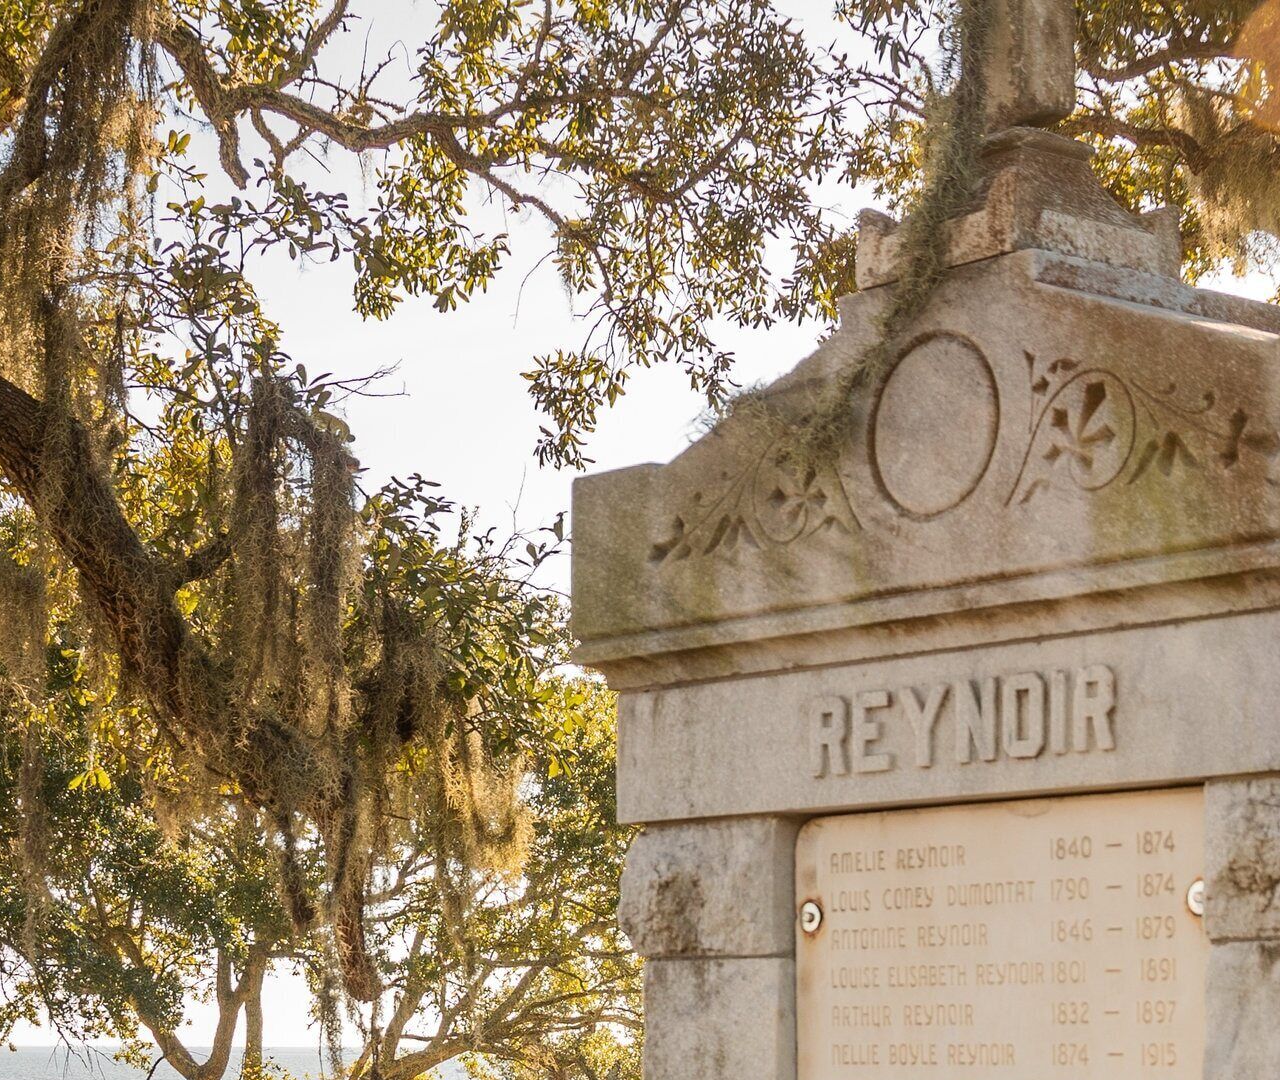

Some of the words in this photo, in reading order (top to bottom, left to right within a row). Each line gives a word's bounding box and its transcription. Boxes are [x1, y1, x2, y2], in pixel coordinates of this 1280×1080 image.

[813, 664, 1117, 777] REYNOIR
[829, 849, 887, 875] AMELIE
[895, 843, 967, 871] REYNOIR
[1049, 834, 1093, 862] 1840
[1135, 829, 1177, 856] 1874
[830, 888, 872, 914] LOUIS
[881, 885, 935, 912] CONEY
[1050, 876, 1091, 903] 1790
[1136, 872, 1177, 899] 1874
[830, 925, 907, 952] ANTONINE
[916, 922, 989, 949] REYNOIR
[1050, 917, 1094, 944] 1846
[1135, 914, 1177, 940] 1879
[830, 966, 881, 990] LOUISE
[887, 963, 968, 989] ELISABETH
[975, 960, 1045, 987] REYNOIR
[1050, 959, 1087, 985] 1801
[1140, 957, 1178, 984] 1891
[831, 1004, 893, 1028] ARTHUR
[903, 1002, 975, 1027] REYNOIR
[1051, 1000, 1091, 1027] 1832
[1136, 999, 1178, 1026] 1897
[831, 1043, 881, 1067] NELLIE
[888, 1042, 939, 1068] BOYLE
[946, 1042, 1017, 1068] REYNOIR
[1051, 1042, 1090, 1067] 1874
[1140, 1041, 1178, 1068] 1915
